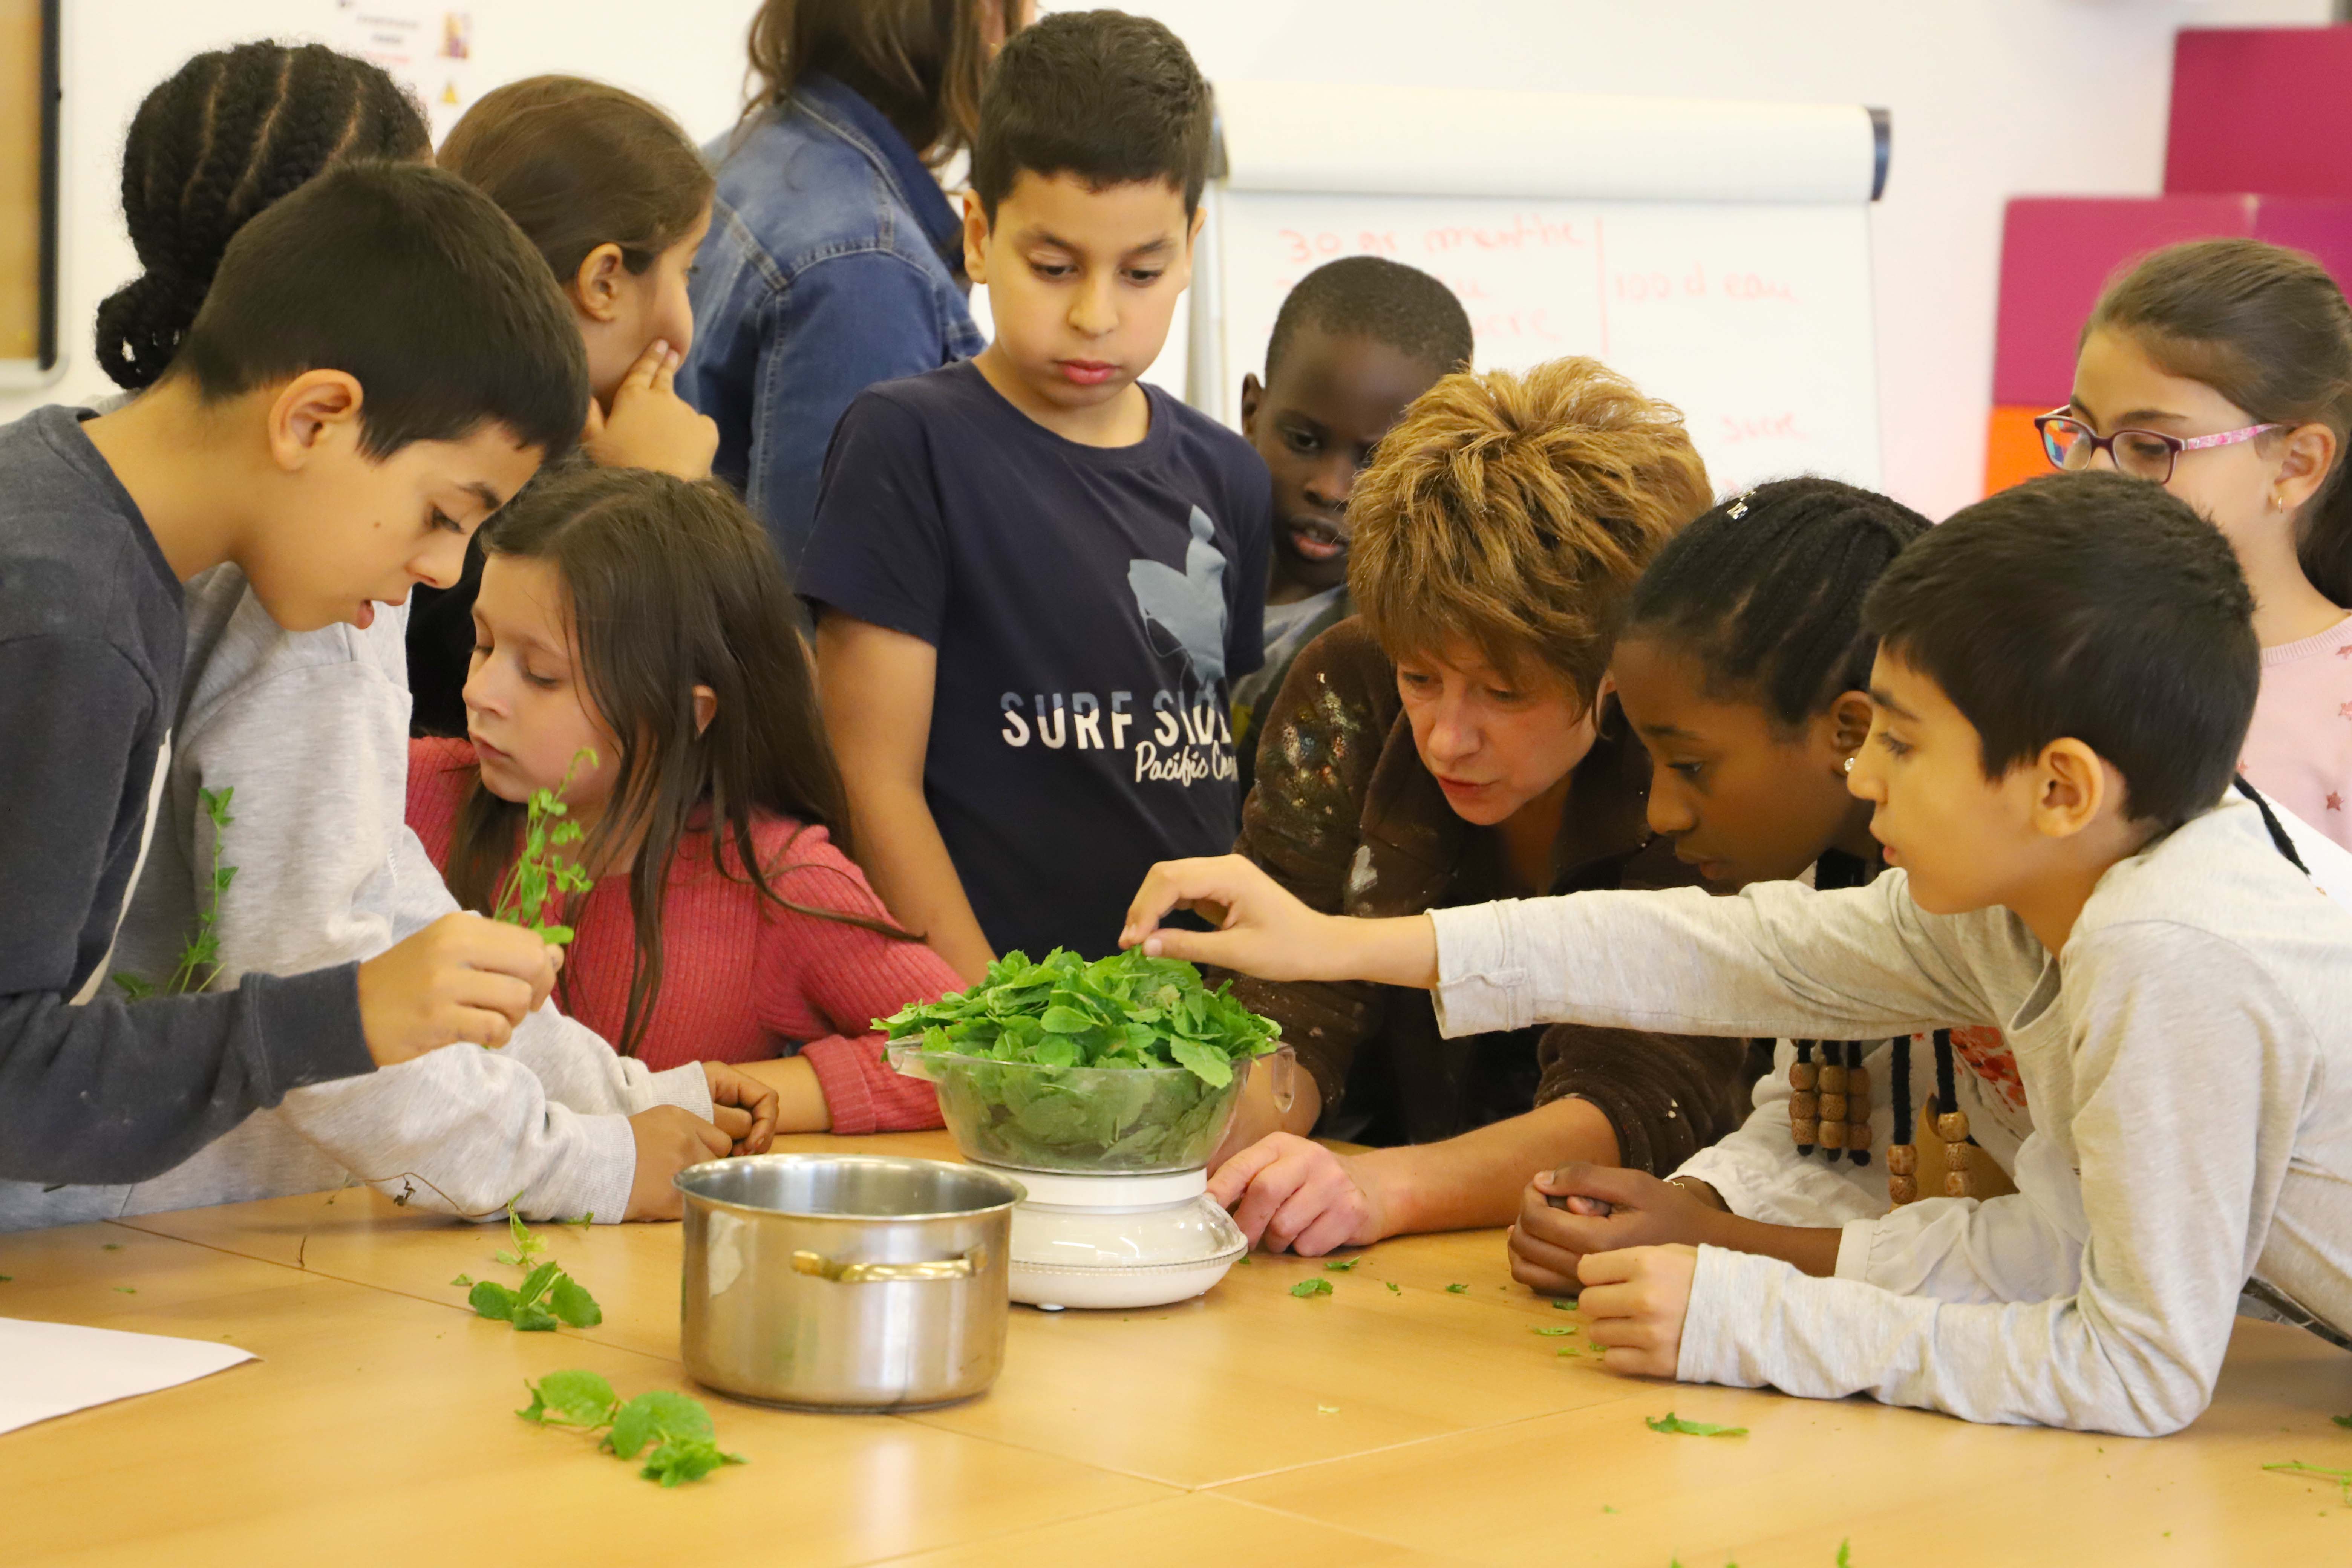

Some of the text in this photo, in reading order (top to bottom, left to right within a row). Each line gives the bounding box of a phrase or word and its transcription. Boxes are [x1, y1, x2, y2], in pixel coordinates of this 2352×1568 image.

[1278, 228, 1342, 263] 30
[1424, 213, 1586, 252] menthe
[1613, 271, 1672, 302] 100
[1721, 271, 1803, 304] eau
[1000, 692, 1132, 750] SURF
[1135, 740, 1209, 787] Pacific
